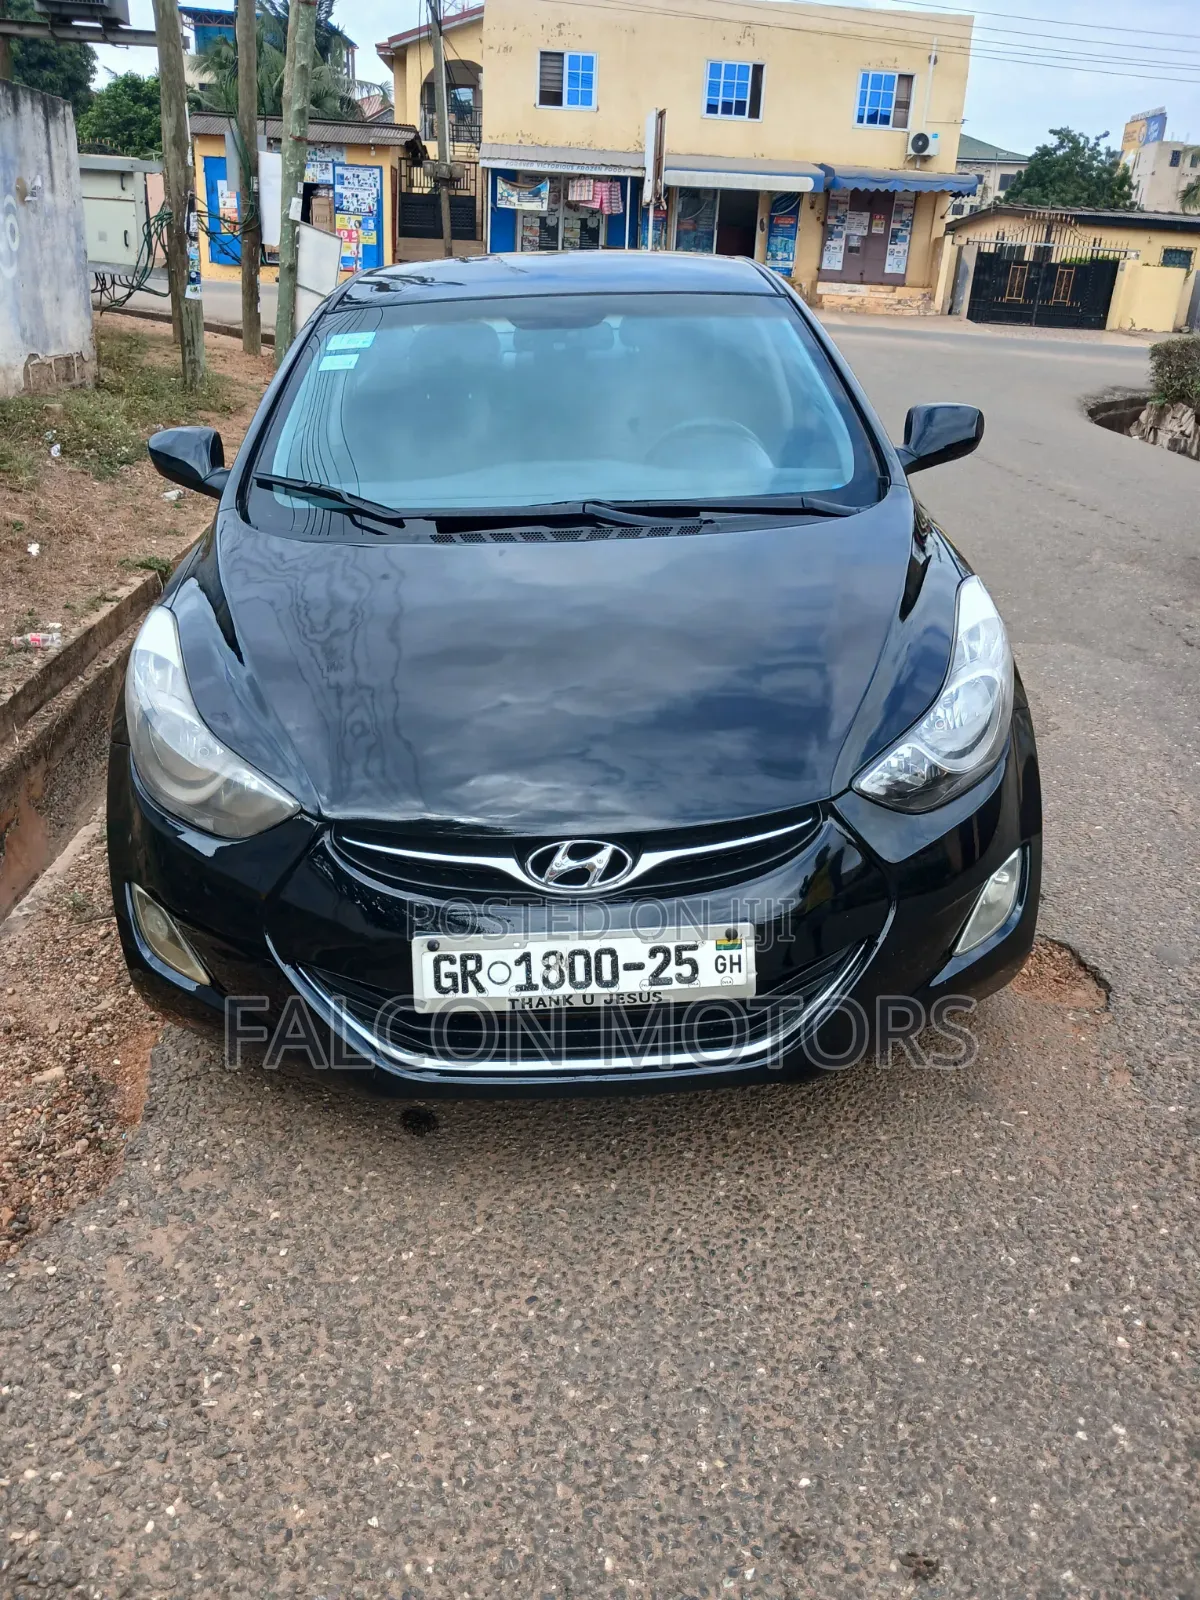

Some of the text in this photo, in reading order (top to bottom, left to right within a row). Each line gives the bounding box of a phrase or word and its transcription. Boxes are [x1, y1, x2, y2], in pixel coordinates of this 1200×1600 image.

[537, 163, 574, 171] VICTORIOUS
[432, 952, 486, 995] GR
[715, 954, 741, 974] GH
[508, 991, 663, 1010] THANK U JESUS
